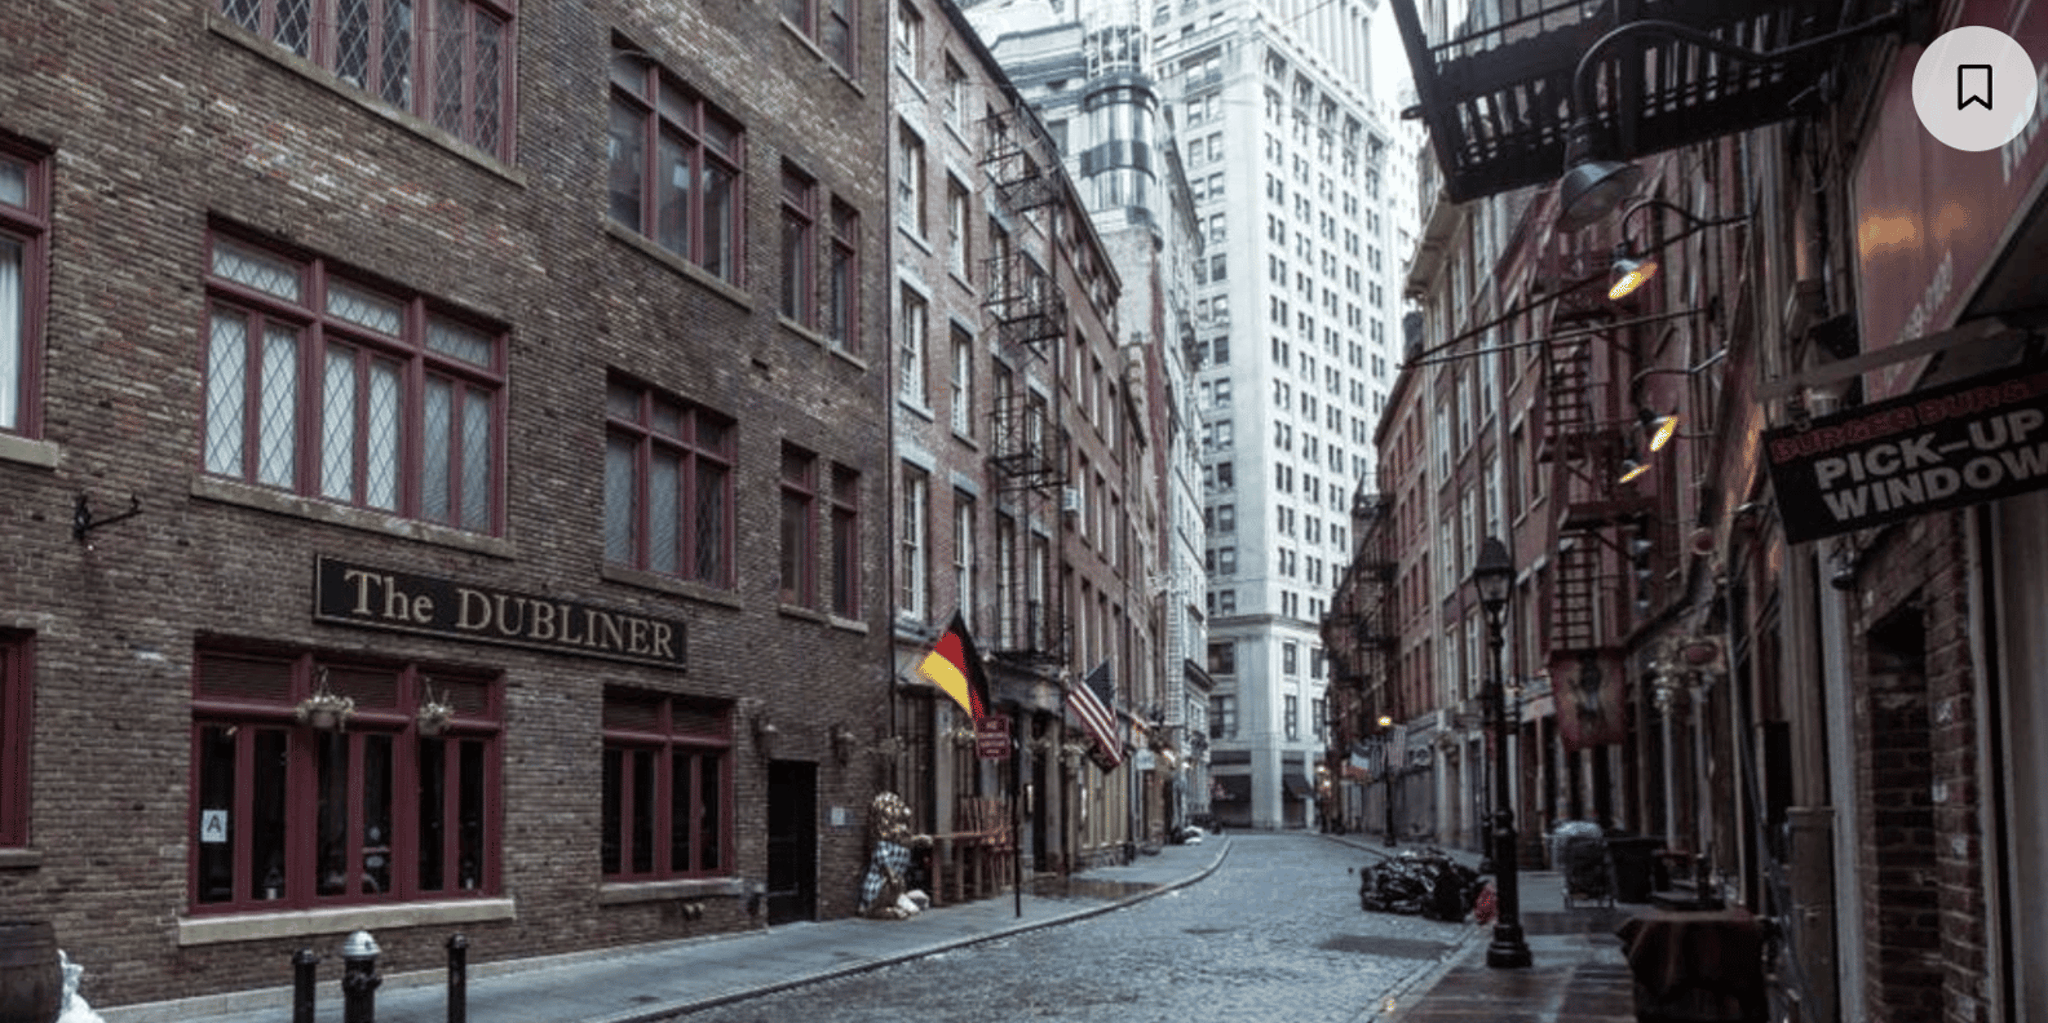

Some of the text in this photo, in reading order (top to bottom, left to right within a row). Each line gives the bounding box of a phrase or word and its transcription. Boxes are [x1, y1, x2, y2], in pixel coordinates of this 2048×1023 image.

[1769, 405, 1918, 464] BURGER
[1814, 408, 2045, 490] PICK-UP
[1822, 441, 2048, 522] WINDOW
[344, 569, 675, 659] The DUBLINER
[207, 814, 222, 833] A
